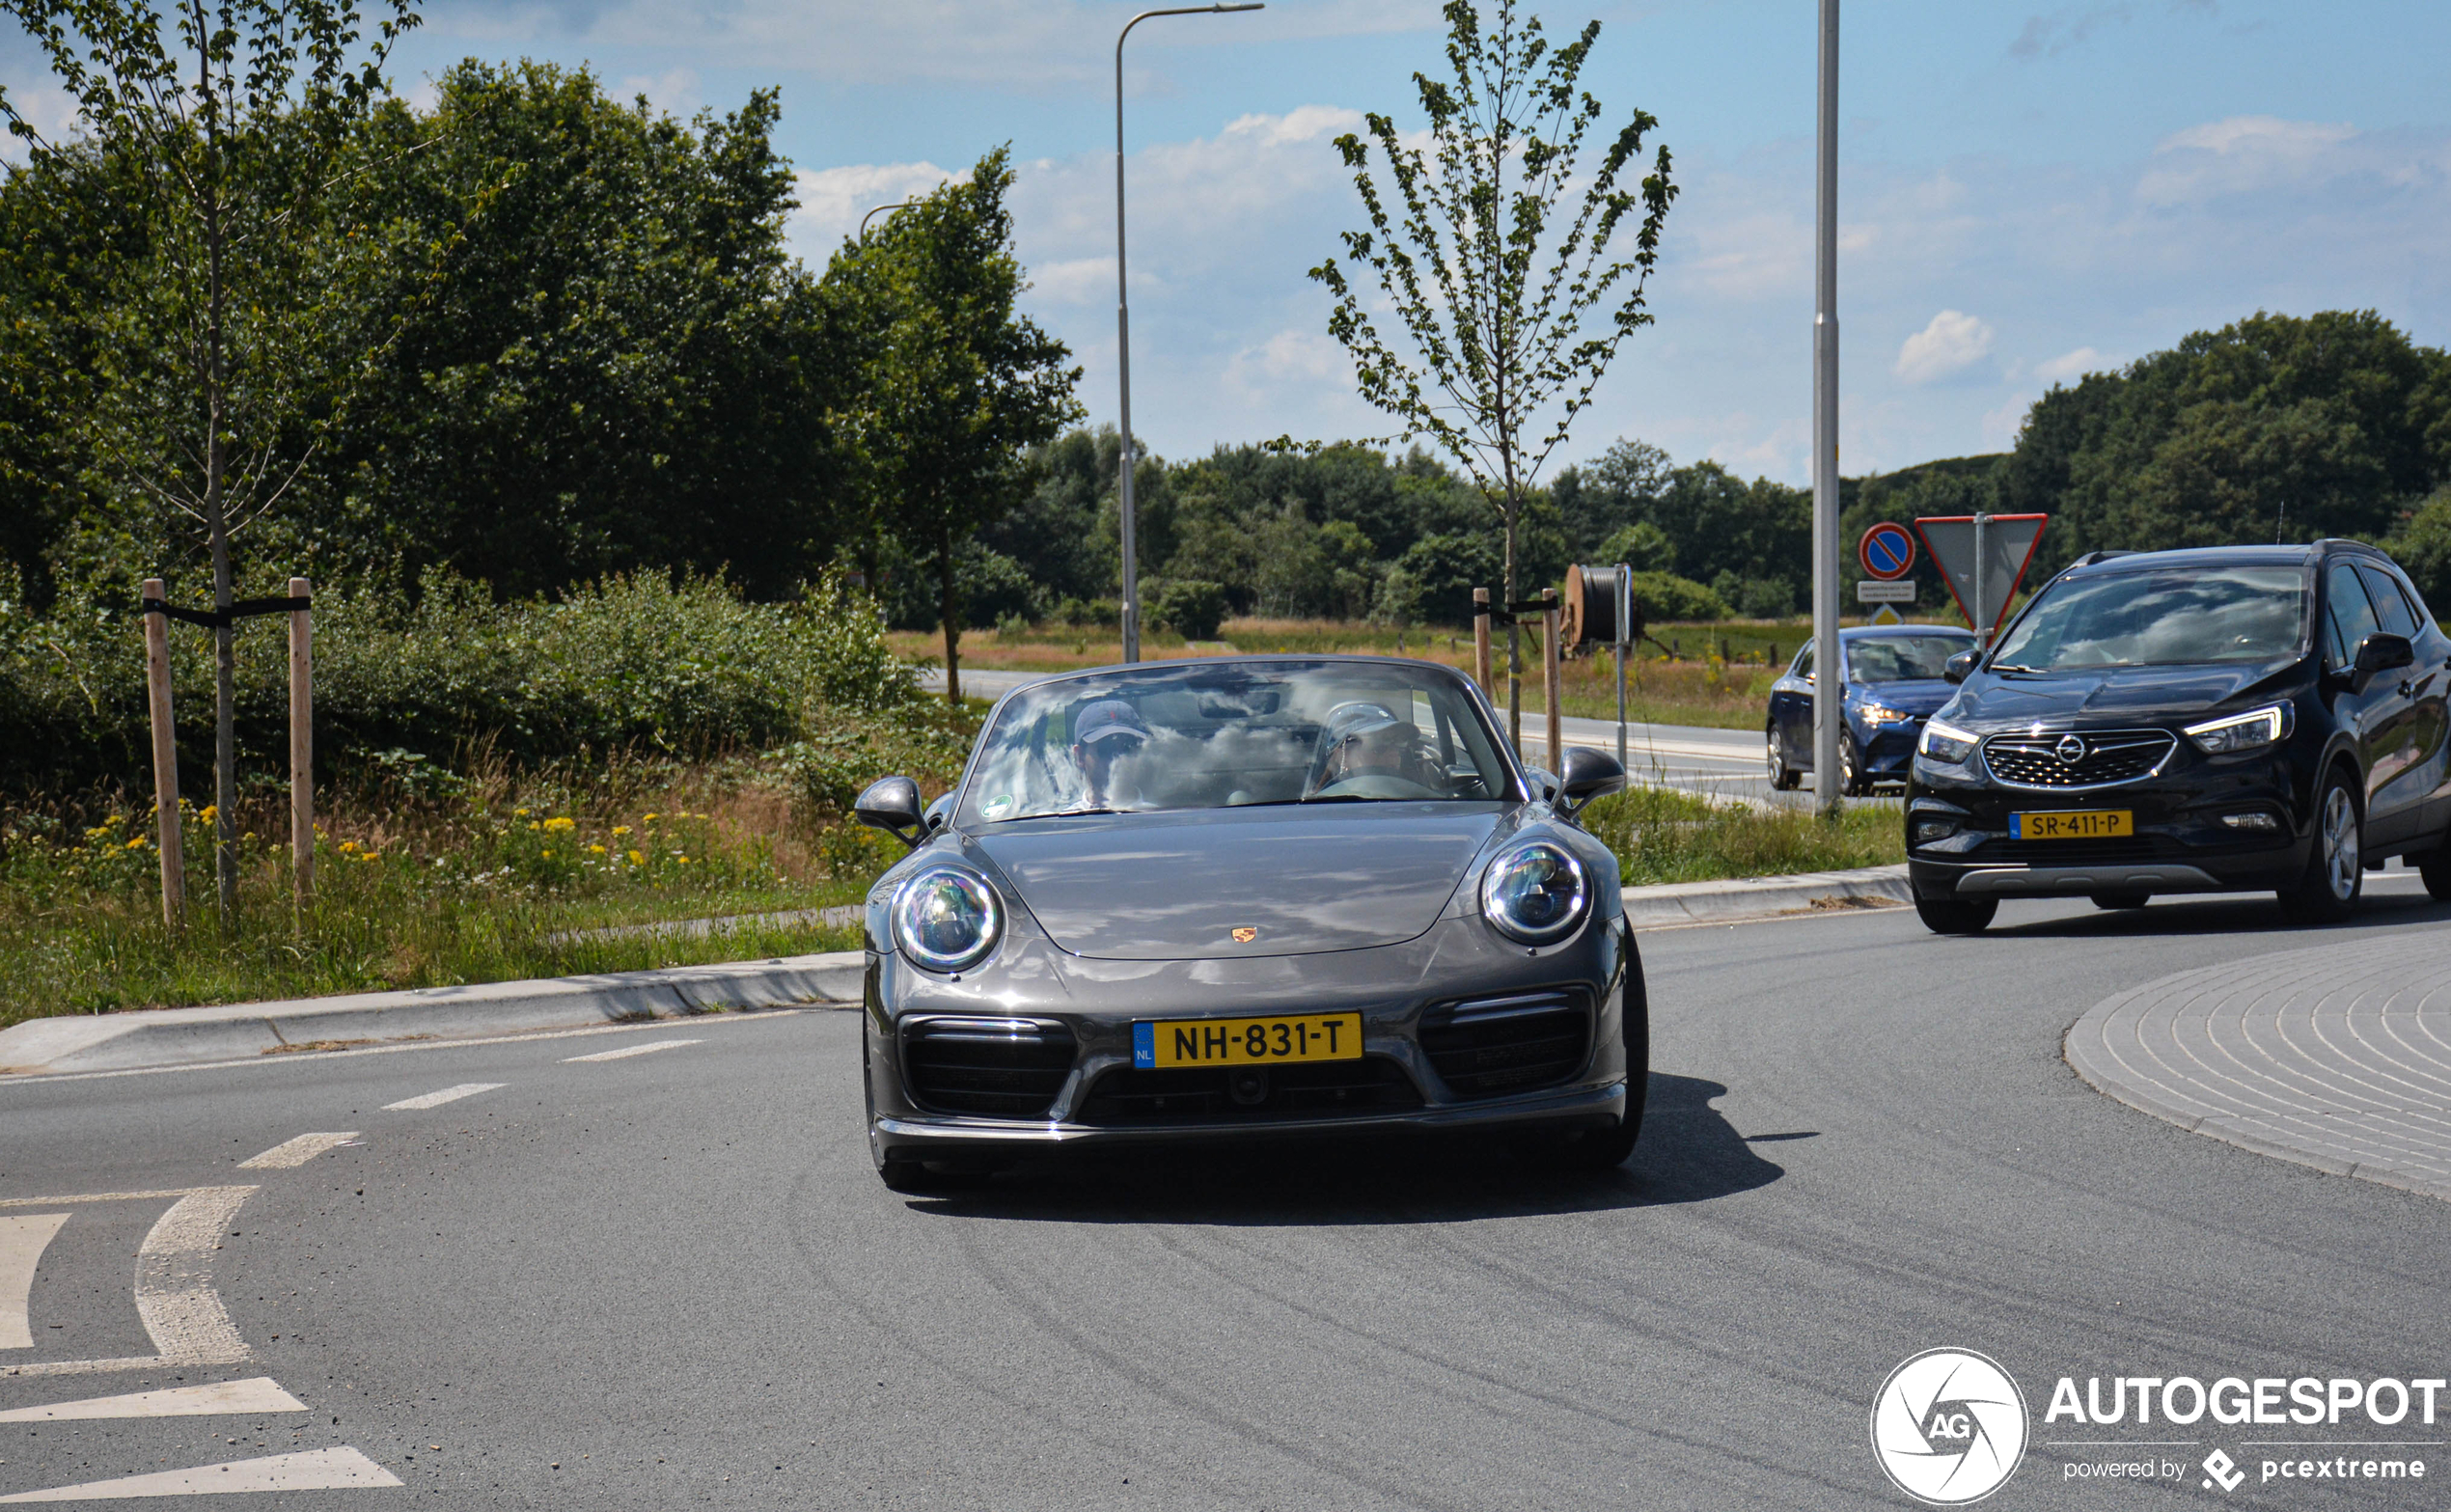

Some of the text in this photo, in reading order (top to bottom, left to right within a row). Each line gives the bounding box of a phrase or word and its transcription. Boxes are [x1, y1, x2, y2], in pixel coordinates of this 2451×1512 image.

[2032, 814, 2120, 836] SR-411-P
[1175, 1021, 1344, 1060] NH-831-T
[1137, 1050, 1152, 1060] NL
